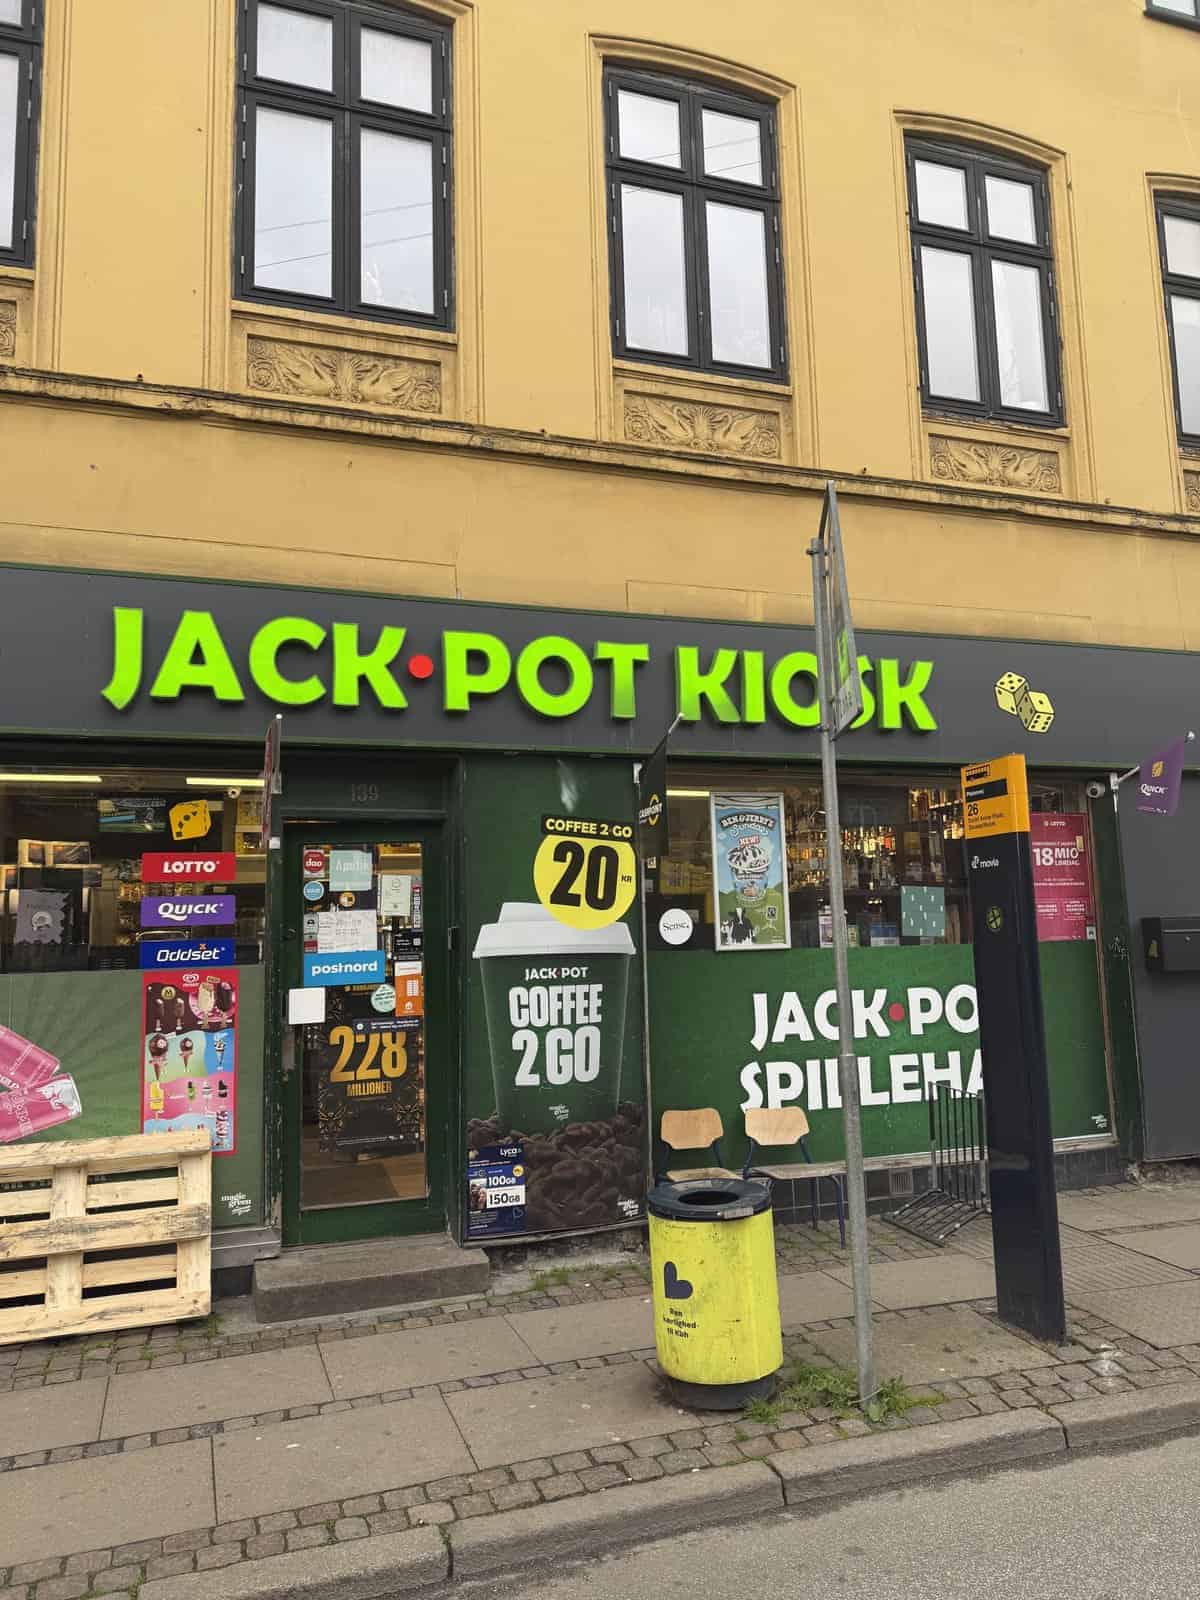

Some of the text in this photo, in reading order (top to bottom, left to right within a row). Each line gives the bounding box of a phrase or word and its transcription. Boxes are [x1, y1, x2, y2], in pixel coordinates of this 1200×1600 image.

[676, 645, 938, 731] KIOSK
[352, 783, 378, 801] 139
[967, 803, 979, 817] 26
[545, 818, 633, 838] COFFEE 2 GO
[980, 858, 1000, 869] movia
[1032, 847, 1079, 866] 18 MIO
[163, 861, 216, 874] LOTTO
[550, 840, 619, 911] 20
[621, 874, 632, 884] KR
[156, 947, 221, 962] Oddset
[312, 960, 378, 977] postnord
[525, 966, 589, 981] JACK POT
[509, 984, 603, 1028] COFFEE
[328, 1025, 408, 1083] 228
[511, 1025, 601, 1087] 2 GO
[347, 1080, 392, 1097] MILLIONER
